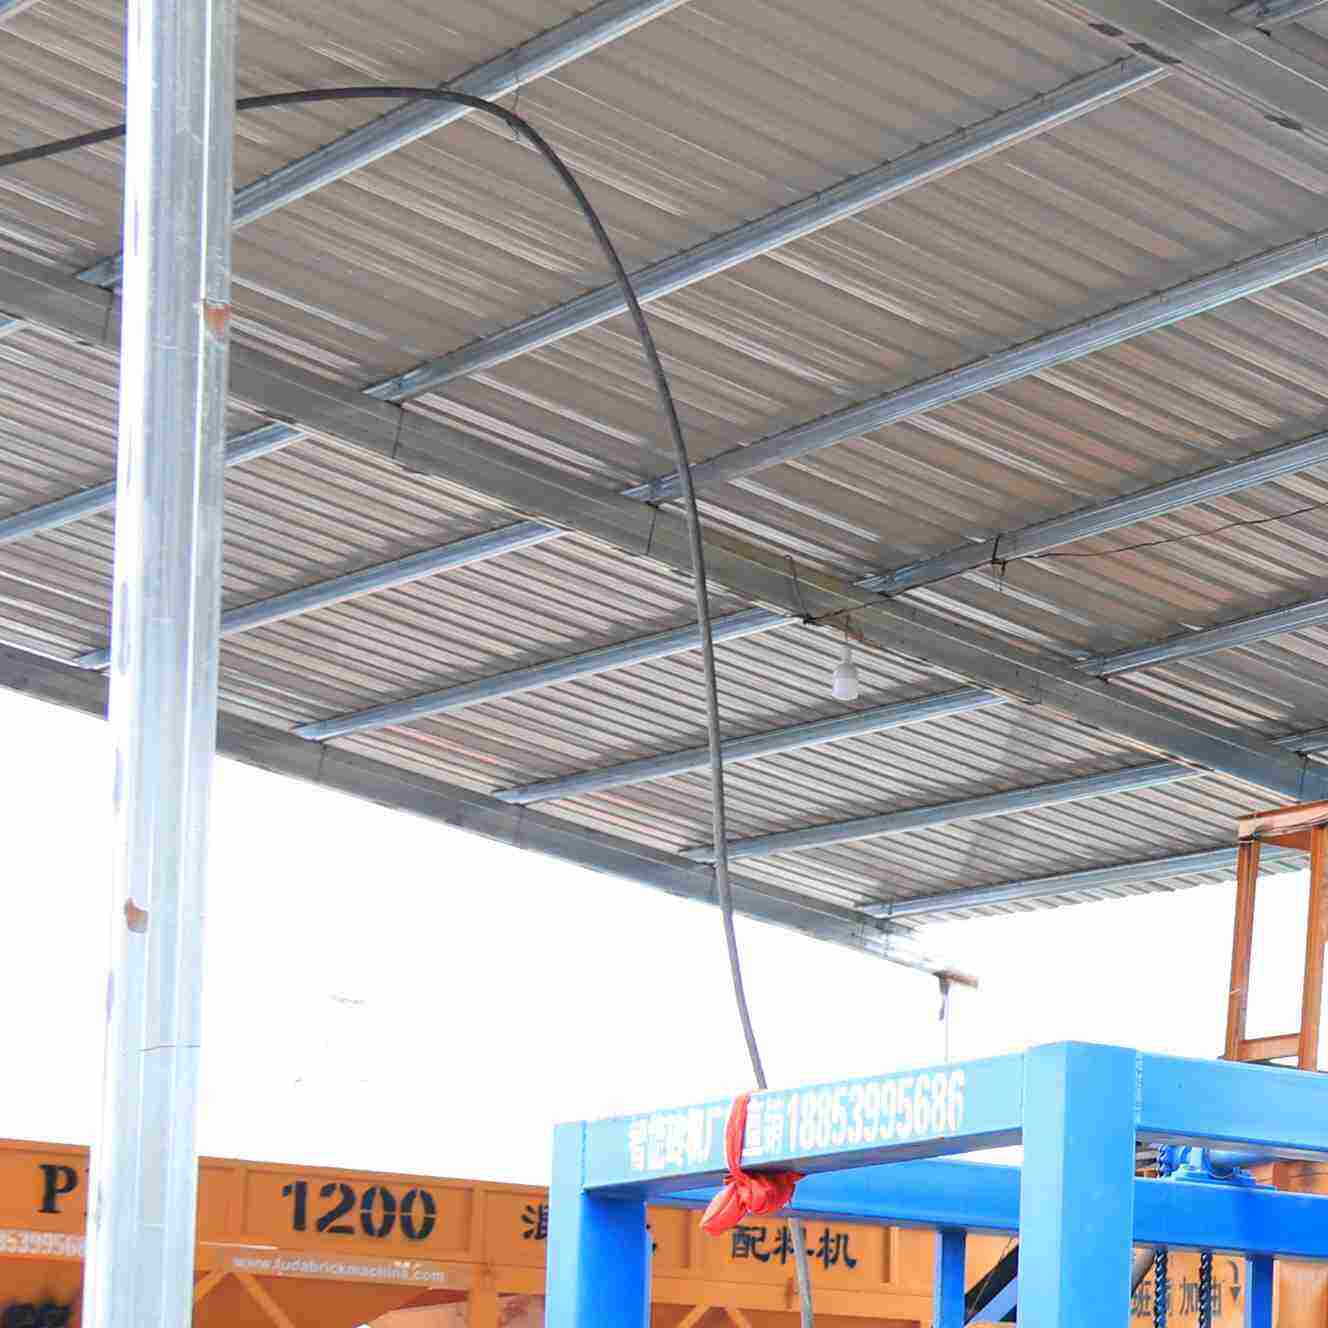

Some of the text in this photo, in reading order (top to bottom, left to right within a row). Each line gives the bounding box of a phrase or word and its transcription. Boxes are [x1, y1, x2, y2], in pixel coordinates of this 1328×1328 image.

[281, 1180, 437, 1241] 1200
[731, 1225, 857, 1269] 配料机
